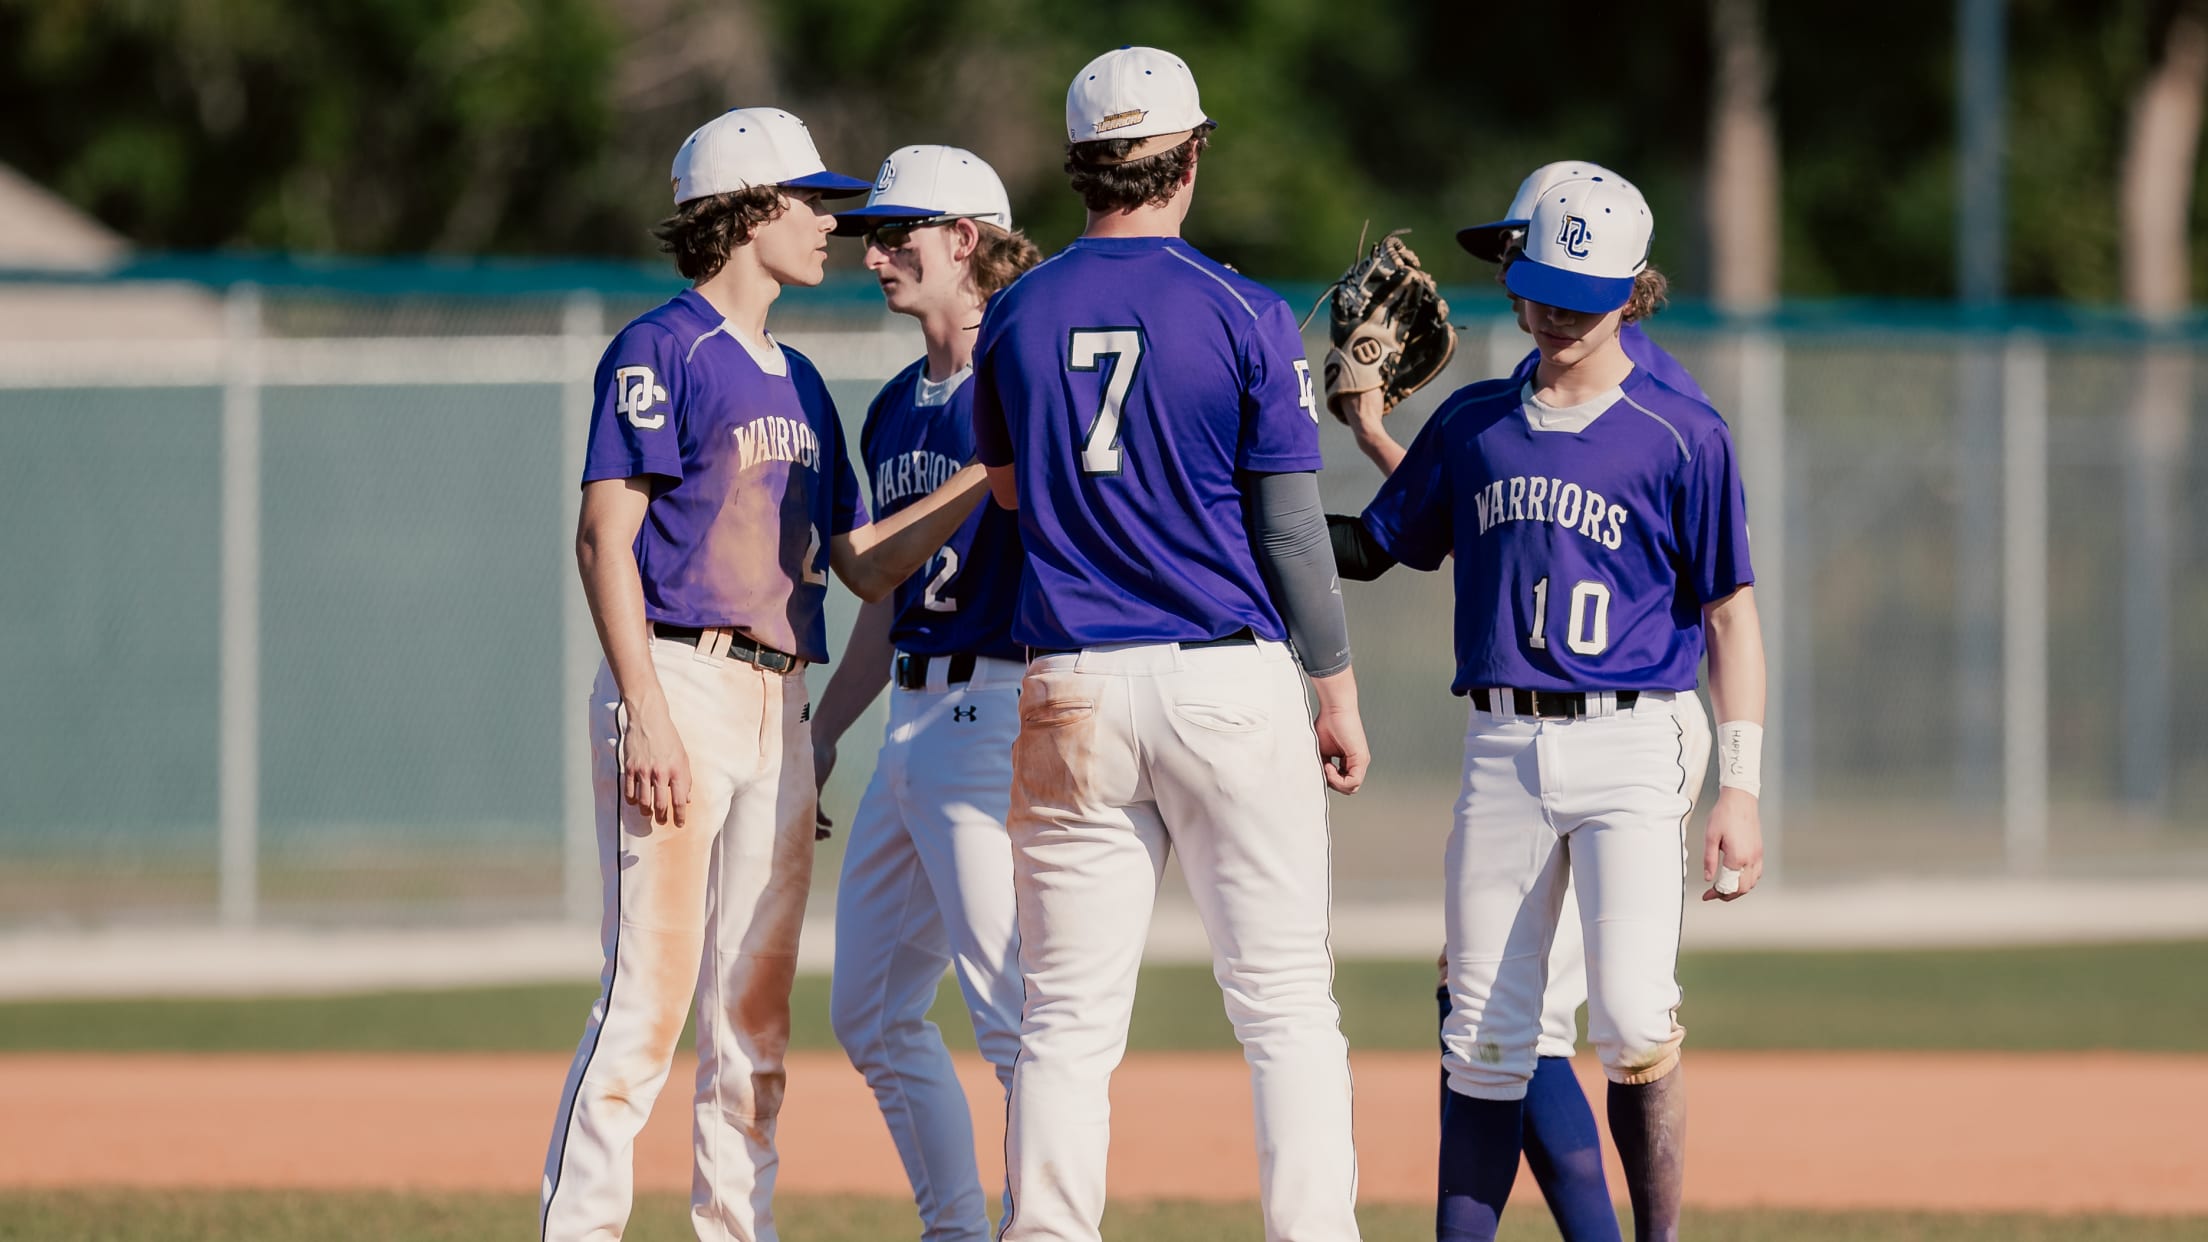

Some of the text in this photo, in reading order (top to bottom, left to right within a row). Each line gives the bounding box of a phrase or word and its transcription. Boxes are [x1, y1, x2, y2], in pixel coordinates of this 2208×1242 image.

[1557, 213, 1592, 260] DC
[616, 366, 666, 429] DC
[1068, 327, 1145, 476] 7
[1475, 476, 1627, 550] WARRIORS
[1529, 577, 1611, 656] 10
[1730, 729, 1742, 762] HAPPY
